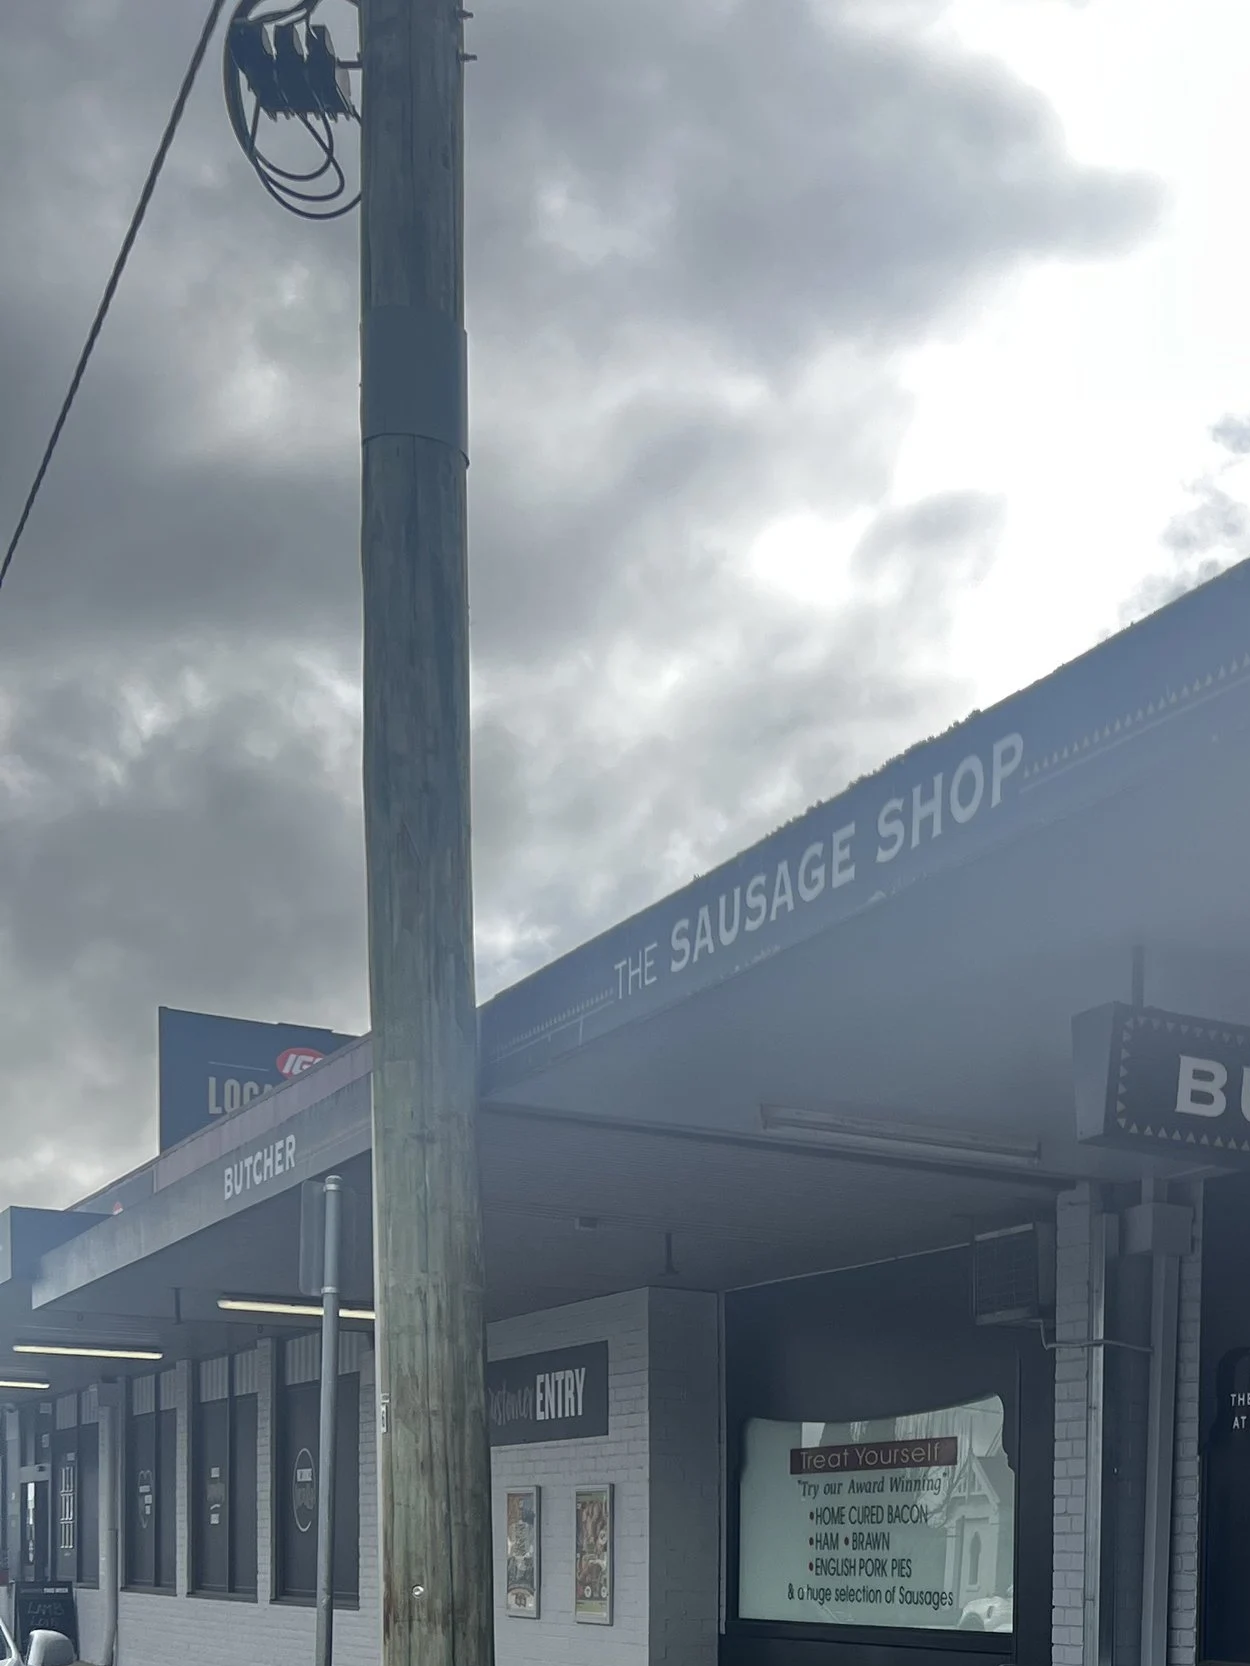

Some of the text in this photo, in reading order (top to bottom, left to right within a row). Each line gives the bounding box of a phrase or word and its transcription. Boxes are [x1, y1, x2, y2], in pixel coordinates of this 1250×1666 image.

[613, 732, 1024, 1000] THE SAUSAGE SHOP
[283, 1053, 326, 1075] IG
[223, 1134, 297, 1201] BUTCHER
[536, 1367, 586, 1421] ENTRY
[1232, 1416, 1247, 1429] AT
[800, 1442, 942, 1470] Treat Yourself
[823, 1481, 844, 1496] our
[847, 1476, 885, 1495] Award
[815, 1503, 929, 1526] HOME CURED BACON
[815, 1532, 840, 1551] HAM
[851, 1532, 891, 1552] BRAWN
[815, 1557, 913, 1579] ENGLISH PORK PIES
[788, 1583, 954, 1611] & a huge selection of Sausages
